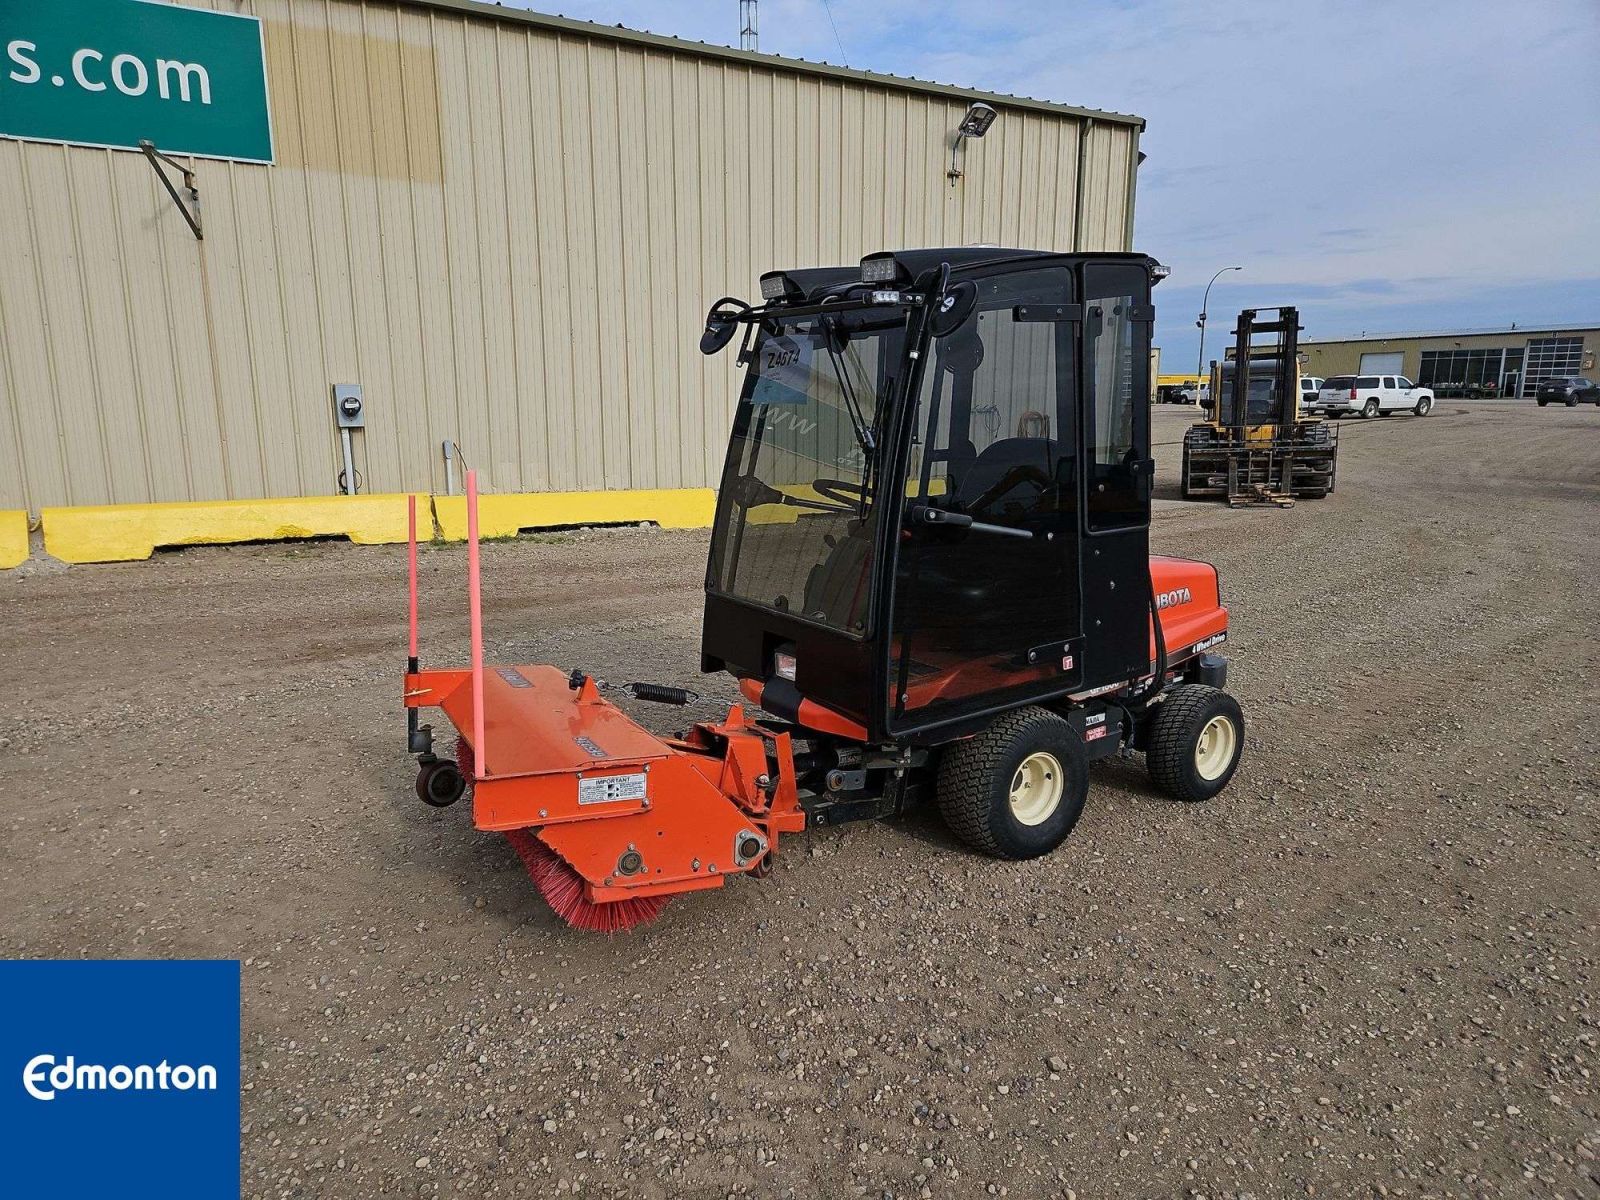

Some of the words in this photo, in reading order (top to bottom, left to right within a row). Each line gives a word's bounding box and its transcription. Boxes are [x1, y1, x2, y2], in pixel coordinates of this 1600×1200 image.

[6, 39, 212, 105] s.com
[1212, 634, 1226, 645] Drive
[595, 776, 631, 785] IMPORTANT
